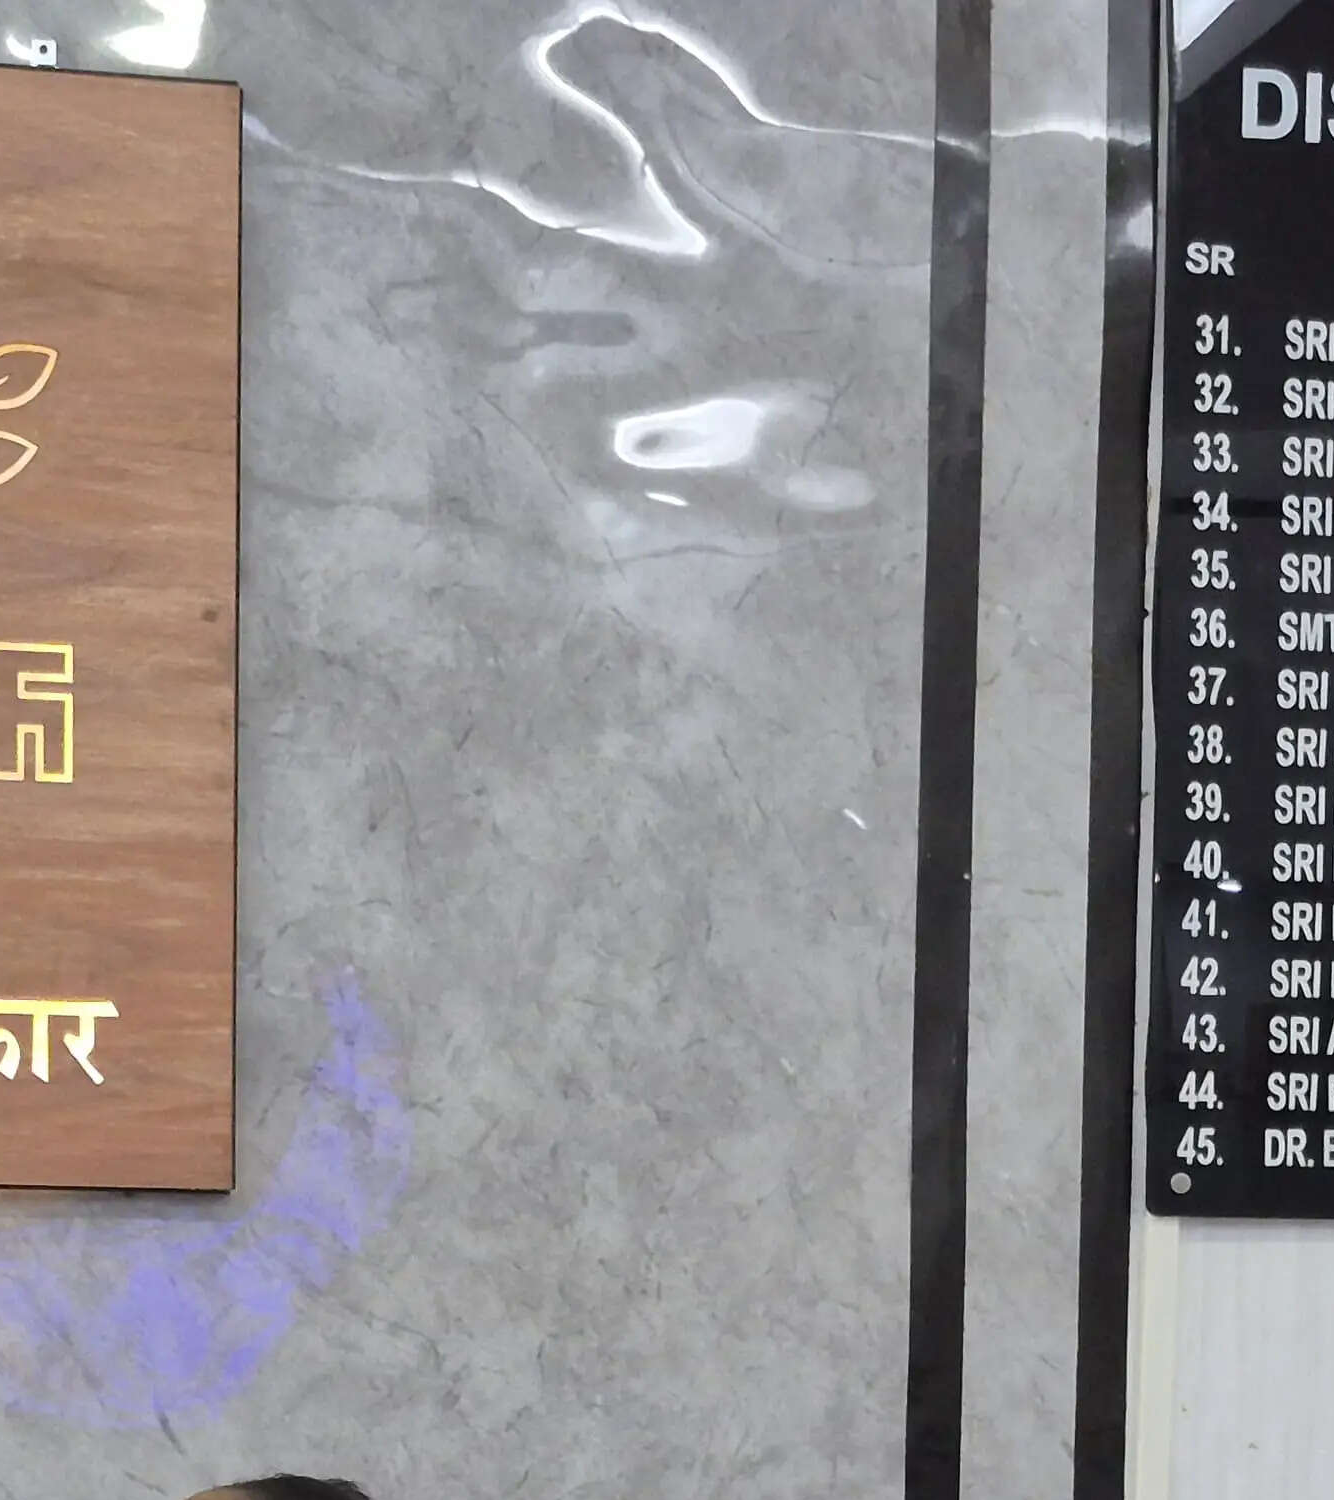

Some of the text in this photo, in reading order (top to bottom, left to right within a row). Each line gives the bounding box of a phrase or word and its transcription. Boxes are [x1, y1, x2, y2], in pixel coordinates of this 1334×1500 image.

[1186, 242, 1234, 275] SR
[1195, 314, 1241, 356] 31.
[1195, 373, 1238, 415] 32.
[1283, 378, 1334, 419] SRI
[1194, 432, 1238, 472] 33.
[1283, 436, 1334, 477] SRI
[1193, 491, 1237, 531] 34.
[1282, 495, 1332, 536] SRI
[1191, 549, 1235, 590] 35.
[1280, 553, 1331, 594] SRI
[1190, 608, 1235, 648] 36.
[1188, 725, 1231, 763] 38.
[1276, 727, 1327, 768] SRI
[1186, 781, 1230, 822] 39.
[1275, 785, 1325, 824] SRI
[1184, 840, 1229, 881] 40.
[1273, 842, 1323, 882] SRI
[1181, 956, 1226, 995] 42.
[1270, 959, 1321, 998] SRI
[1179, 1071, 1223, 1109] 44.
[1267, 1072, 1318, 1111] SRI
[1177, 1127, 1223, 1165] 45.
[1265, 1128, 1314, 1167] DR.
